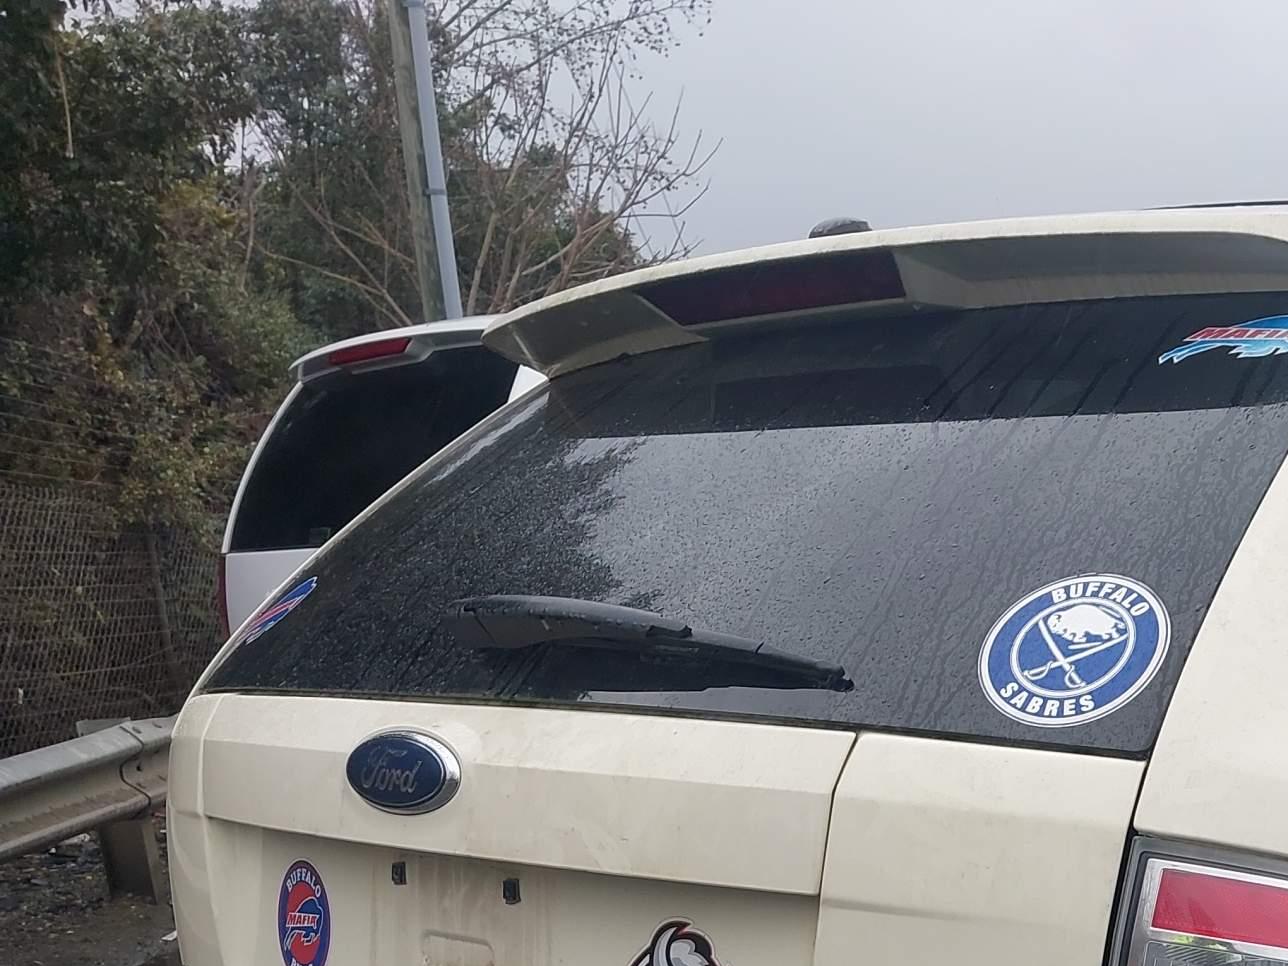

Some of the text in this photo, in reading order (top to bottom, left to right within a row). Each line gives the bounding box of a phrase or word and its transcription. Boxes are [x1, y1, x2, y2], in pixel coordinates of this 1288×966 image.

[1051, 582, 1150, 617] BUFFALO
[1000, 682, 1095, 716] SABRES
[361, 745, 423, 793] Ford
[286, 867, 321, 897] BUFFALO
[286, 912, 320, 928] MAFIA
